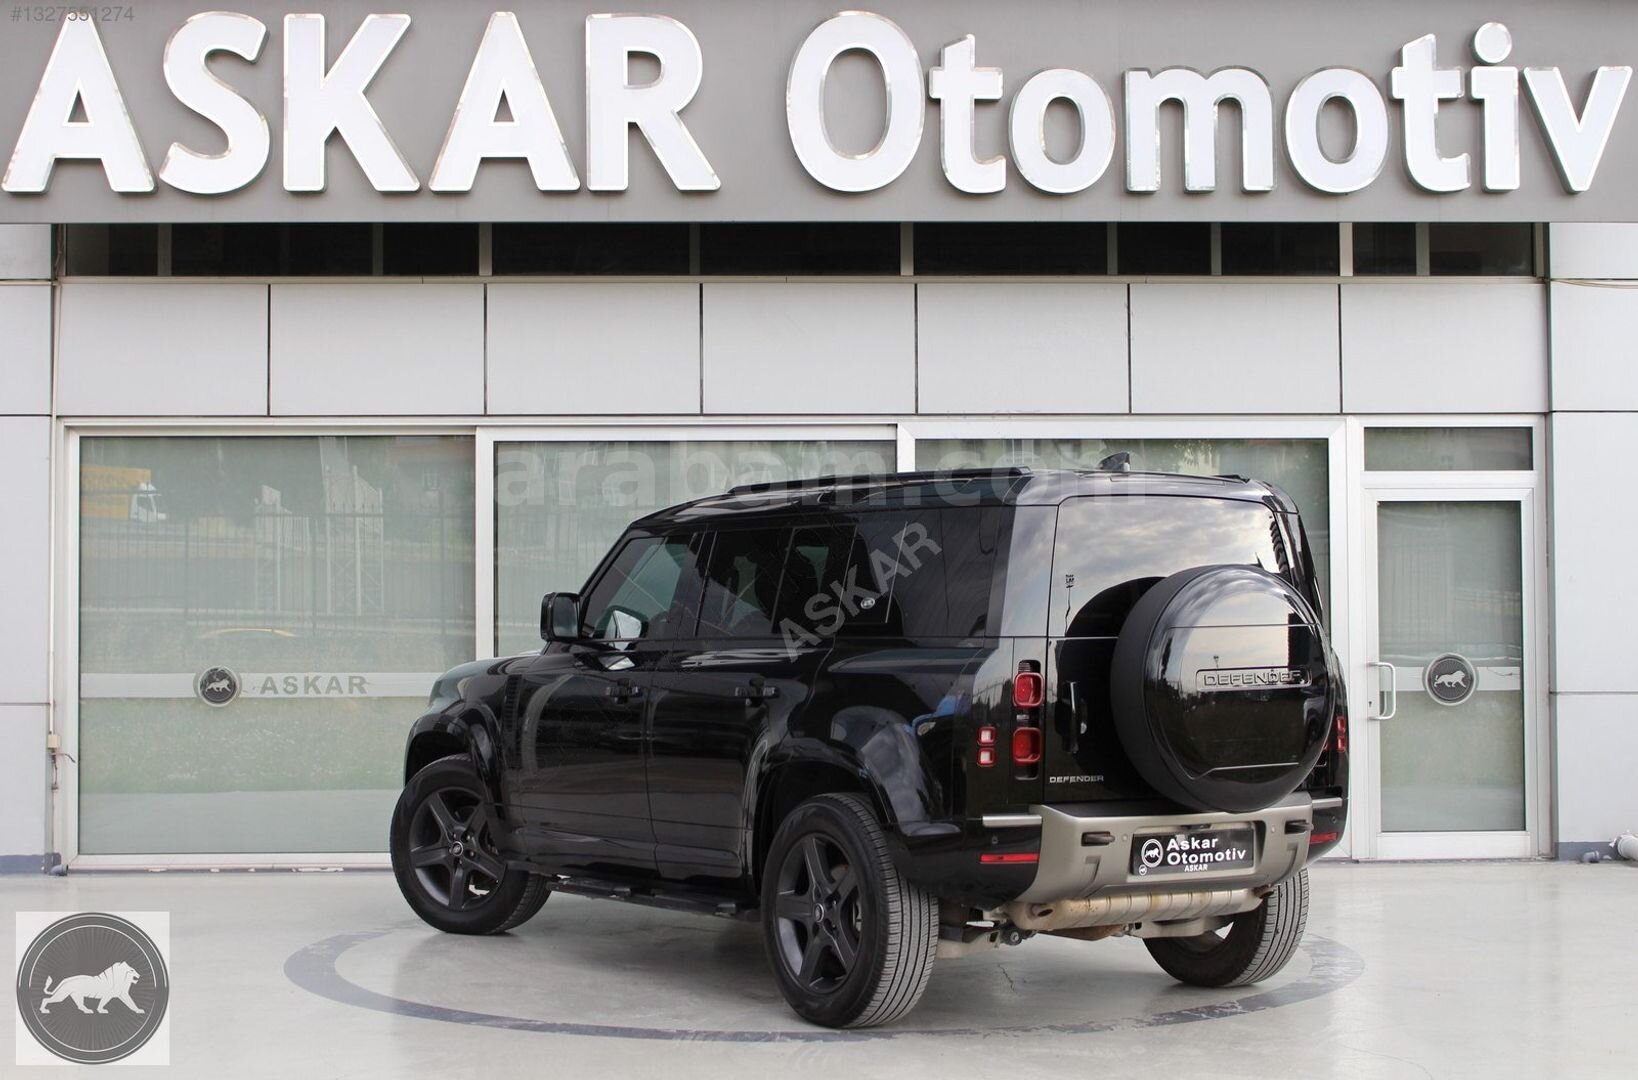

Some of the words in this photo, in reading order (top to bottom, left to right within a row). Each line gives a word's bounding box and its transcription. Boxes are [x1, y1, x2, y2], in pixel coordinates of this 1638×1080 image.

[2, 11, 721, 194] ASKAR
[785, 9, 1634, 195] Otomotiv
[259, 675, 368, 695] ASKAR
[1203, 670, 1305, 686] DEFENDER
[1049, 774, 1104, 784] DEFENDER
[1166, 837, 1219, 851] Askar
[1167, 847, 1247, 866] Otomotiv
[1184, 863, 1208, 872] ASKAR
